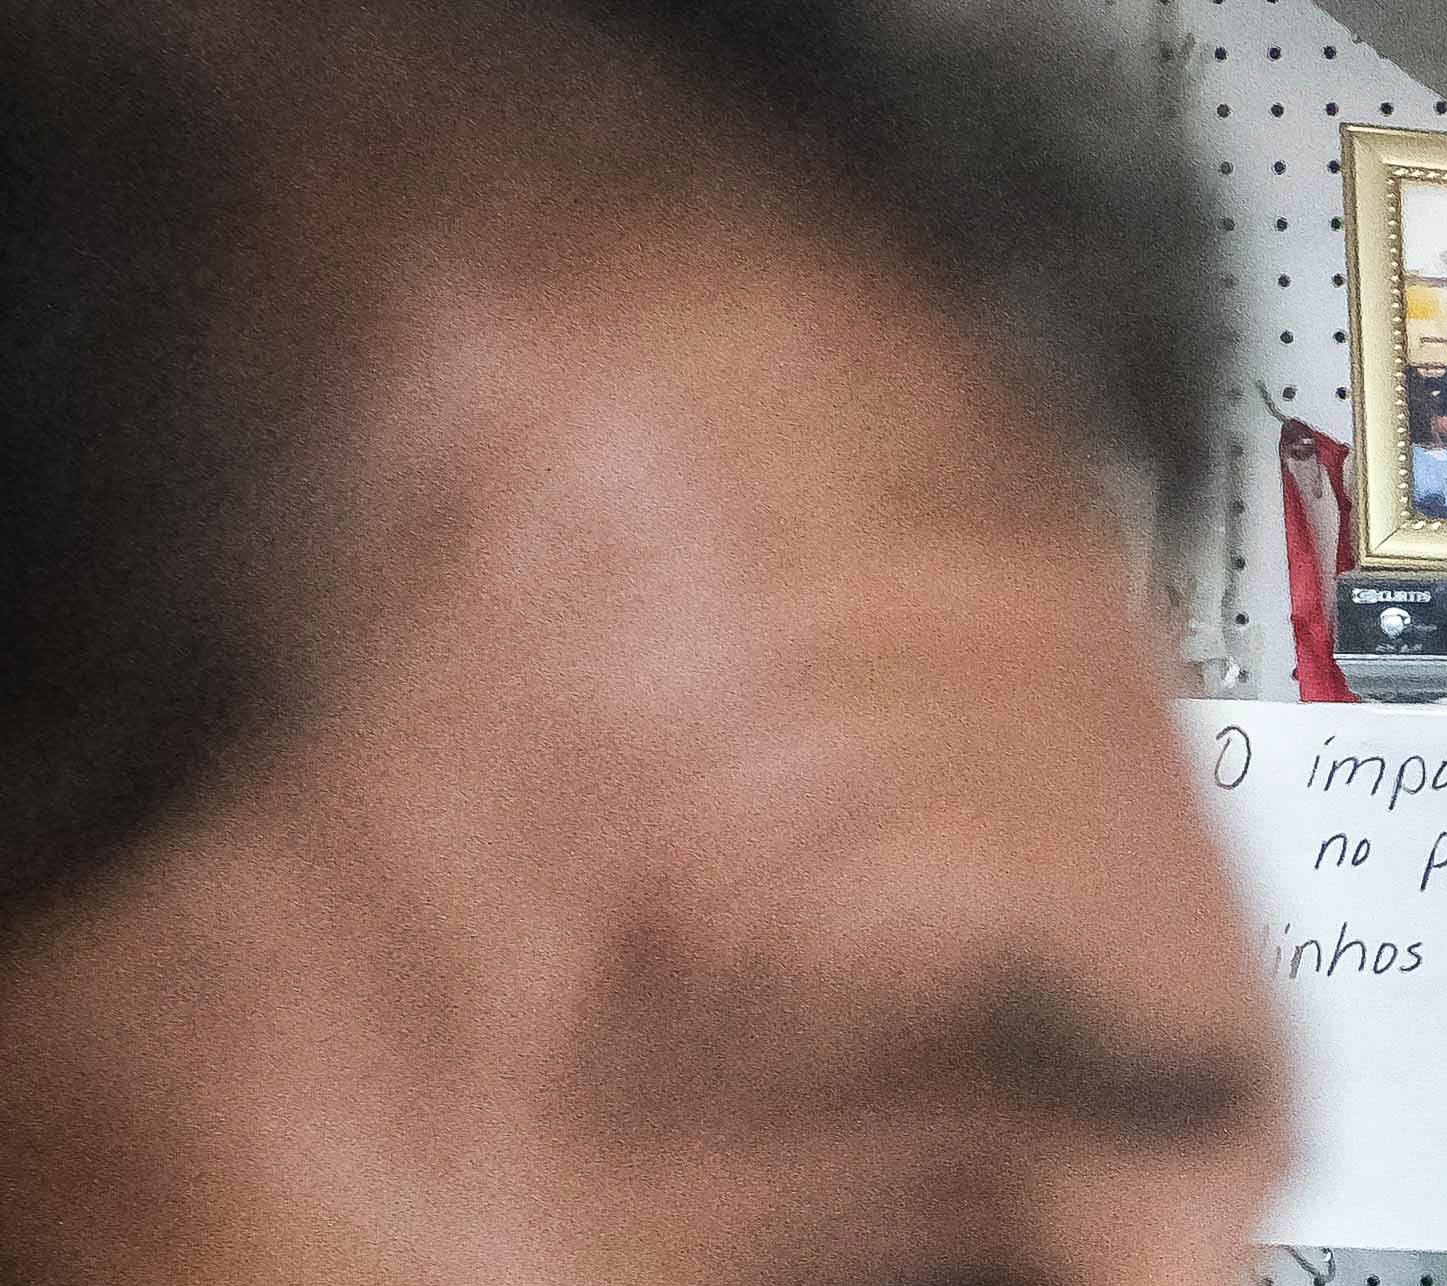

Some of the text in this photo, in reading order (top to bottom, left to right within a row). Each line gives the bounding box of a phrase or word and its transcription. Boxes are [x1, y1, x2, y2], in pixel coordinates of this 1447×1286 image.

[1213, 725, 1253, 790] O
[1314, 834, 1372, 871] no
[1274, 922, 1423, 980] inhos
